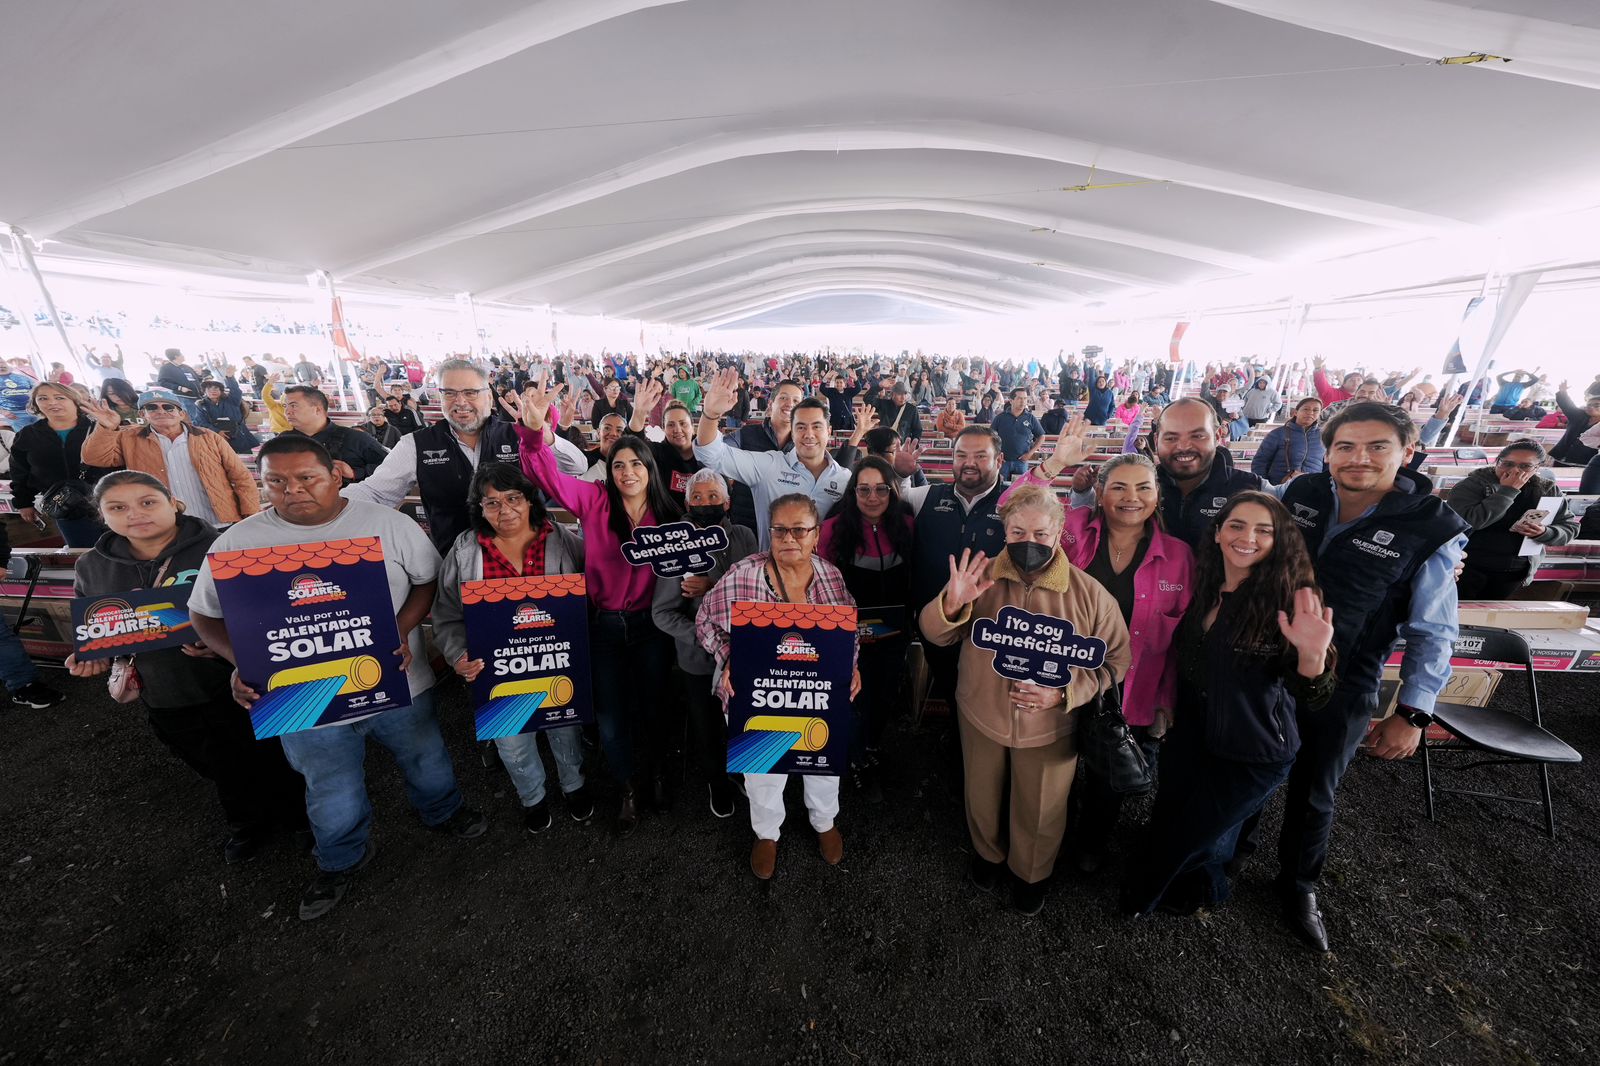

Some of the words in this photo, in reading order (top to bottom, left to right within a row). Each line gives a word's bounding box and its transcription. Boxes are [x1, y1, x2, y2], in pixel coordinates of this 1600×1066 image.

[665, 529, 689, 540] soy
[630, 534, 720, 559] beneficiario!
[1352, 539, 1400, 558] QUERÉTARO
[287, 585, 341, 600] SOLARES
[88, 610, 149, 624] CALENTADORES
[286, 614, 310, 624] Vale
[314, 612, 332, 621] por
[512, 614, 551, 624] SOLARES
[76, 616, 160, 640] SOLARES
[266, 616, 372, 640] CALENTADOR
[1034, 623, 1063, 640] soy
[268, 628, 374, 662] SOLAR
[494, 642, 570, 657] CALENTADOR
[776, 645, 816, 654] SOLARES
[982, 628, 1095, 660] beneficiario!
[1462, 640, 1481, 648] 107
[494, 652, 570, 676] SOLAR
[754, 678, 832, 690] CALENTADOR
[752, 689, 829, 710] SOLAR
